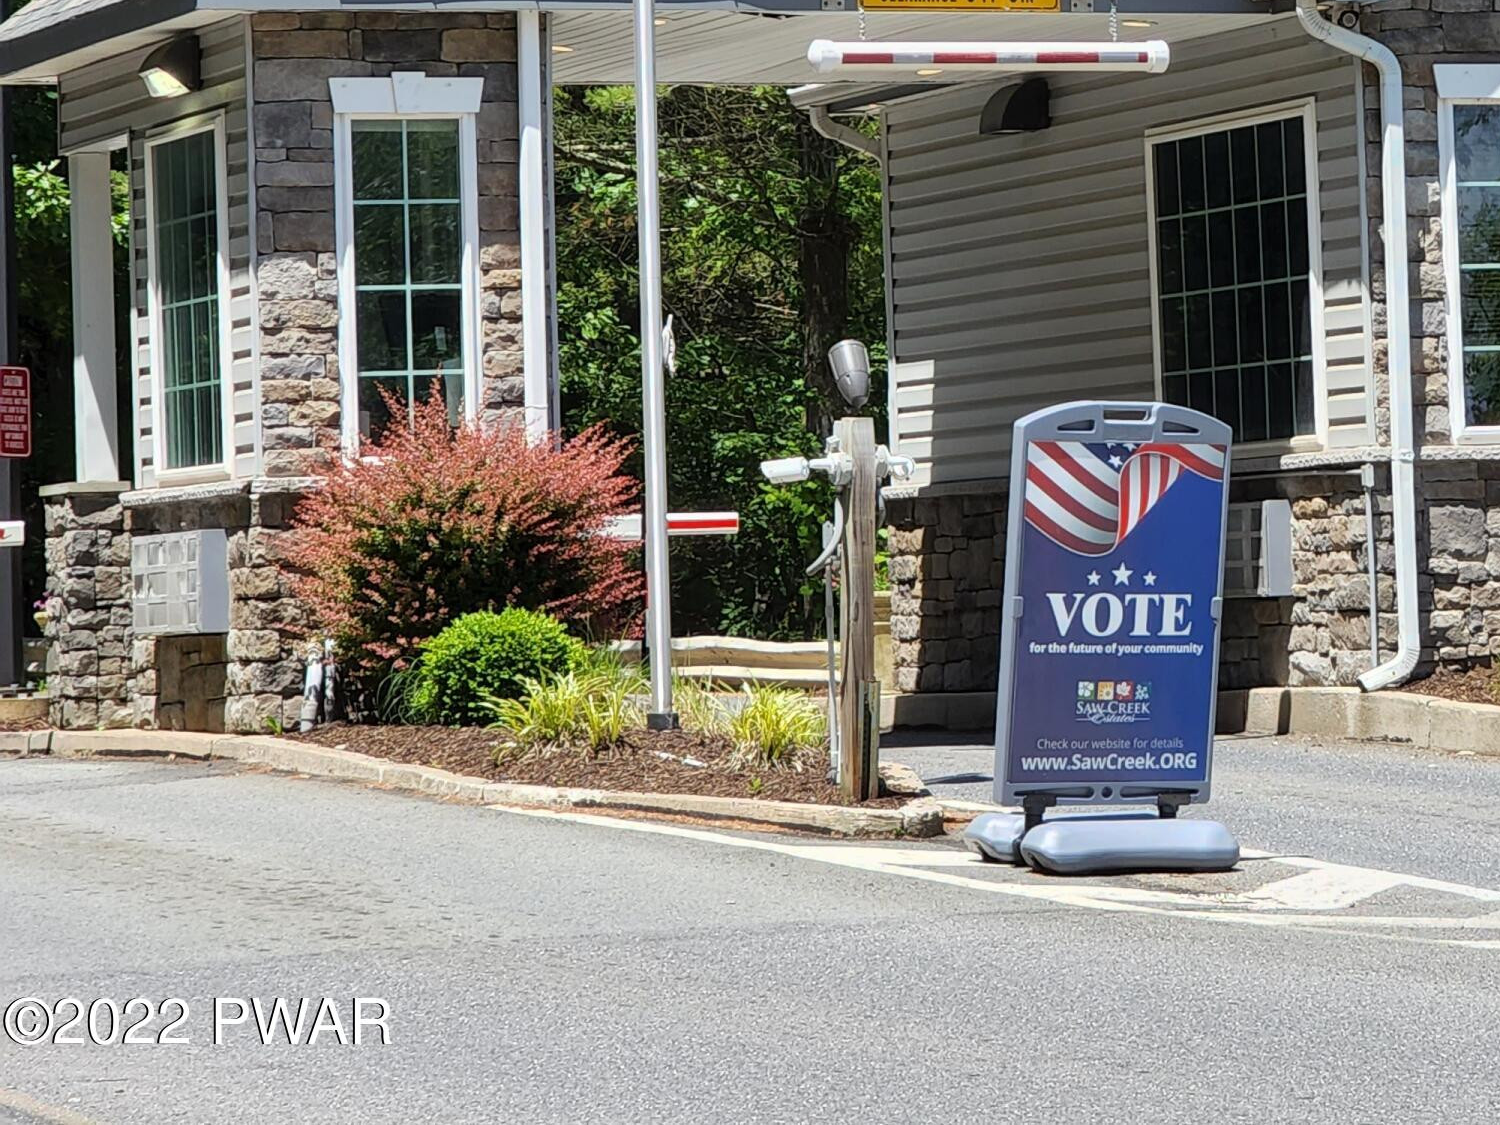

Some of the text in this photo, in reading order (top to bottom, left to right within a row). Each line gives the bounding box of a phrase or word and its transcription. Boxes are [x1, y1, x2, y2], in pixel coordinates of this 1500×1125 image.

[1046, 592, 1192, 637] VOTE
[1029, 642, 1203, 656] for the future of your community
[1076, 701, 1151, 715] SAW CREEK
[1037, 737, 1184, 749] Check our website for details
[1021, 752, 1197, 771] www.SawCreek.ORG
